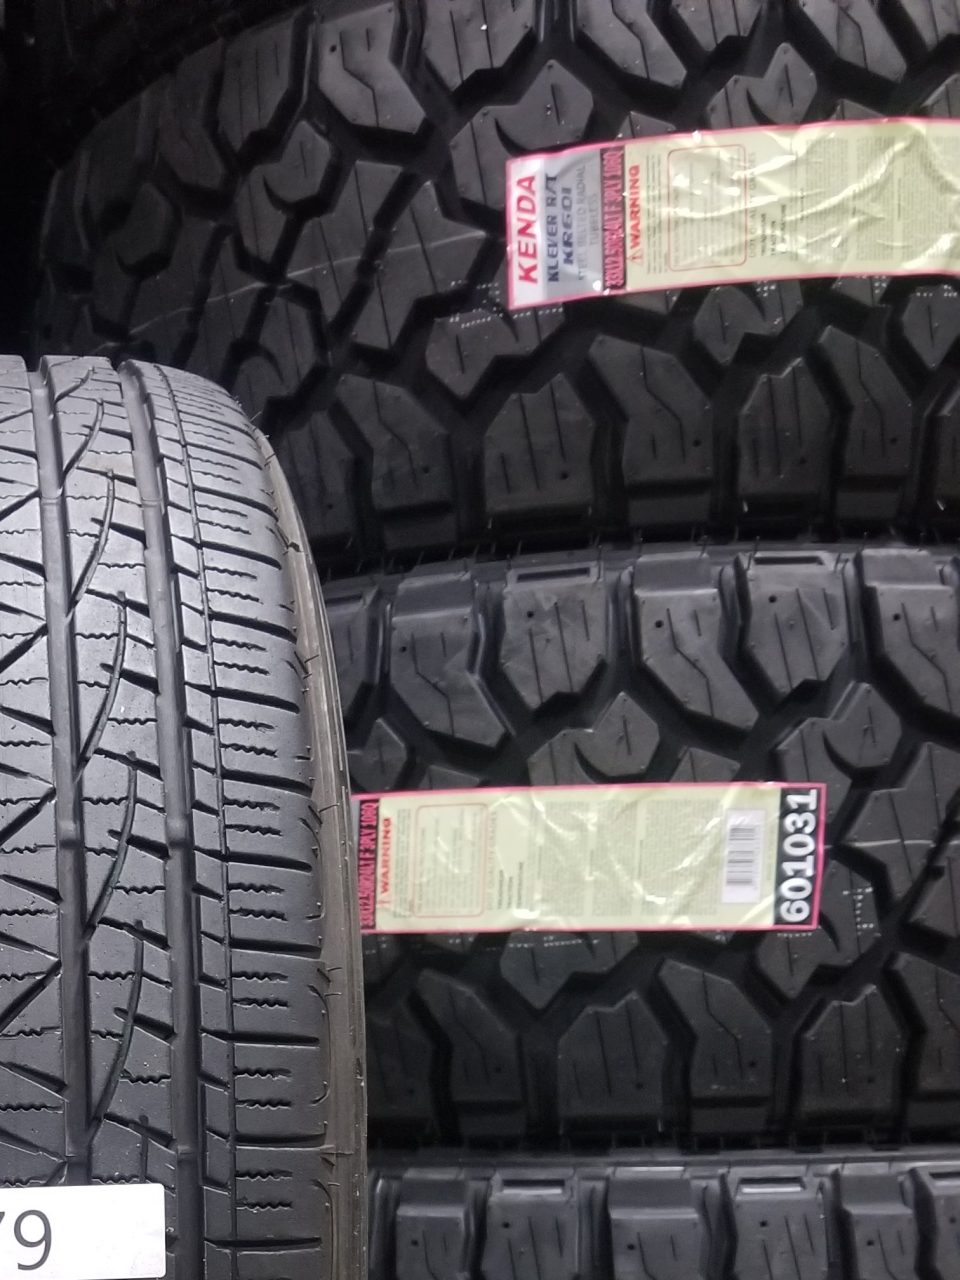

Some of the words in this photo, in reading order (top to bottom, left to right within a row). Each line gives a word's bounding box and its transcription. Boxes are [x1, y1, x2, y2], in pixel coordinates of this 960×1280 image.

[516, 174, 538, 284] KENDA
[545, 172, 558, 207] R/T
[628, 164, 641, 250] WARNING
[545, 214, 560, 283] KLEVER
[380, 817, 393, 895] WARNING
[779, 788, 818, 923] 601031
